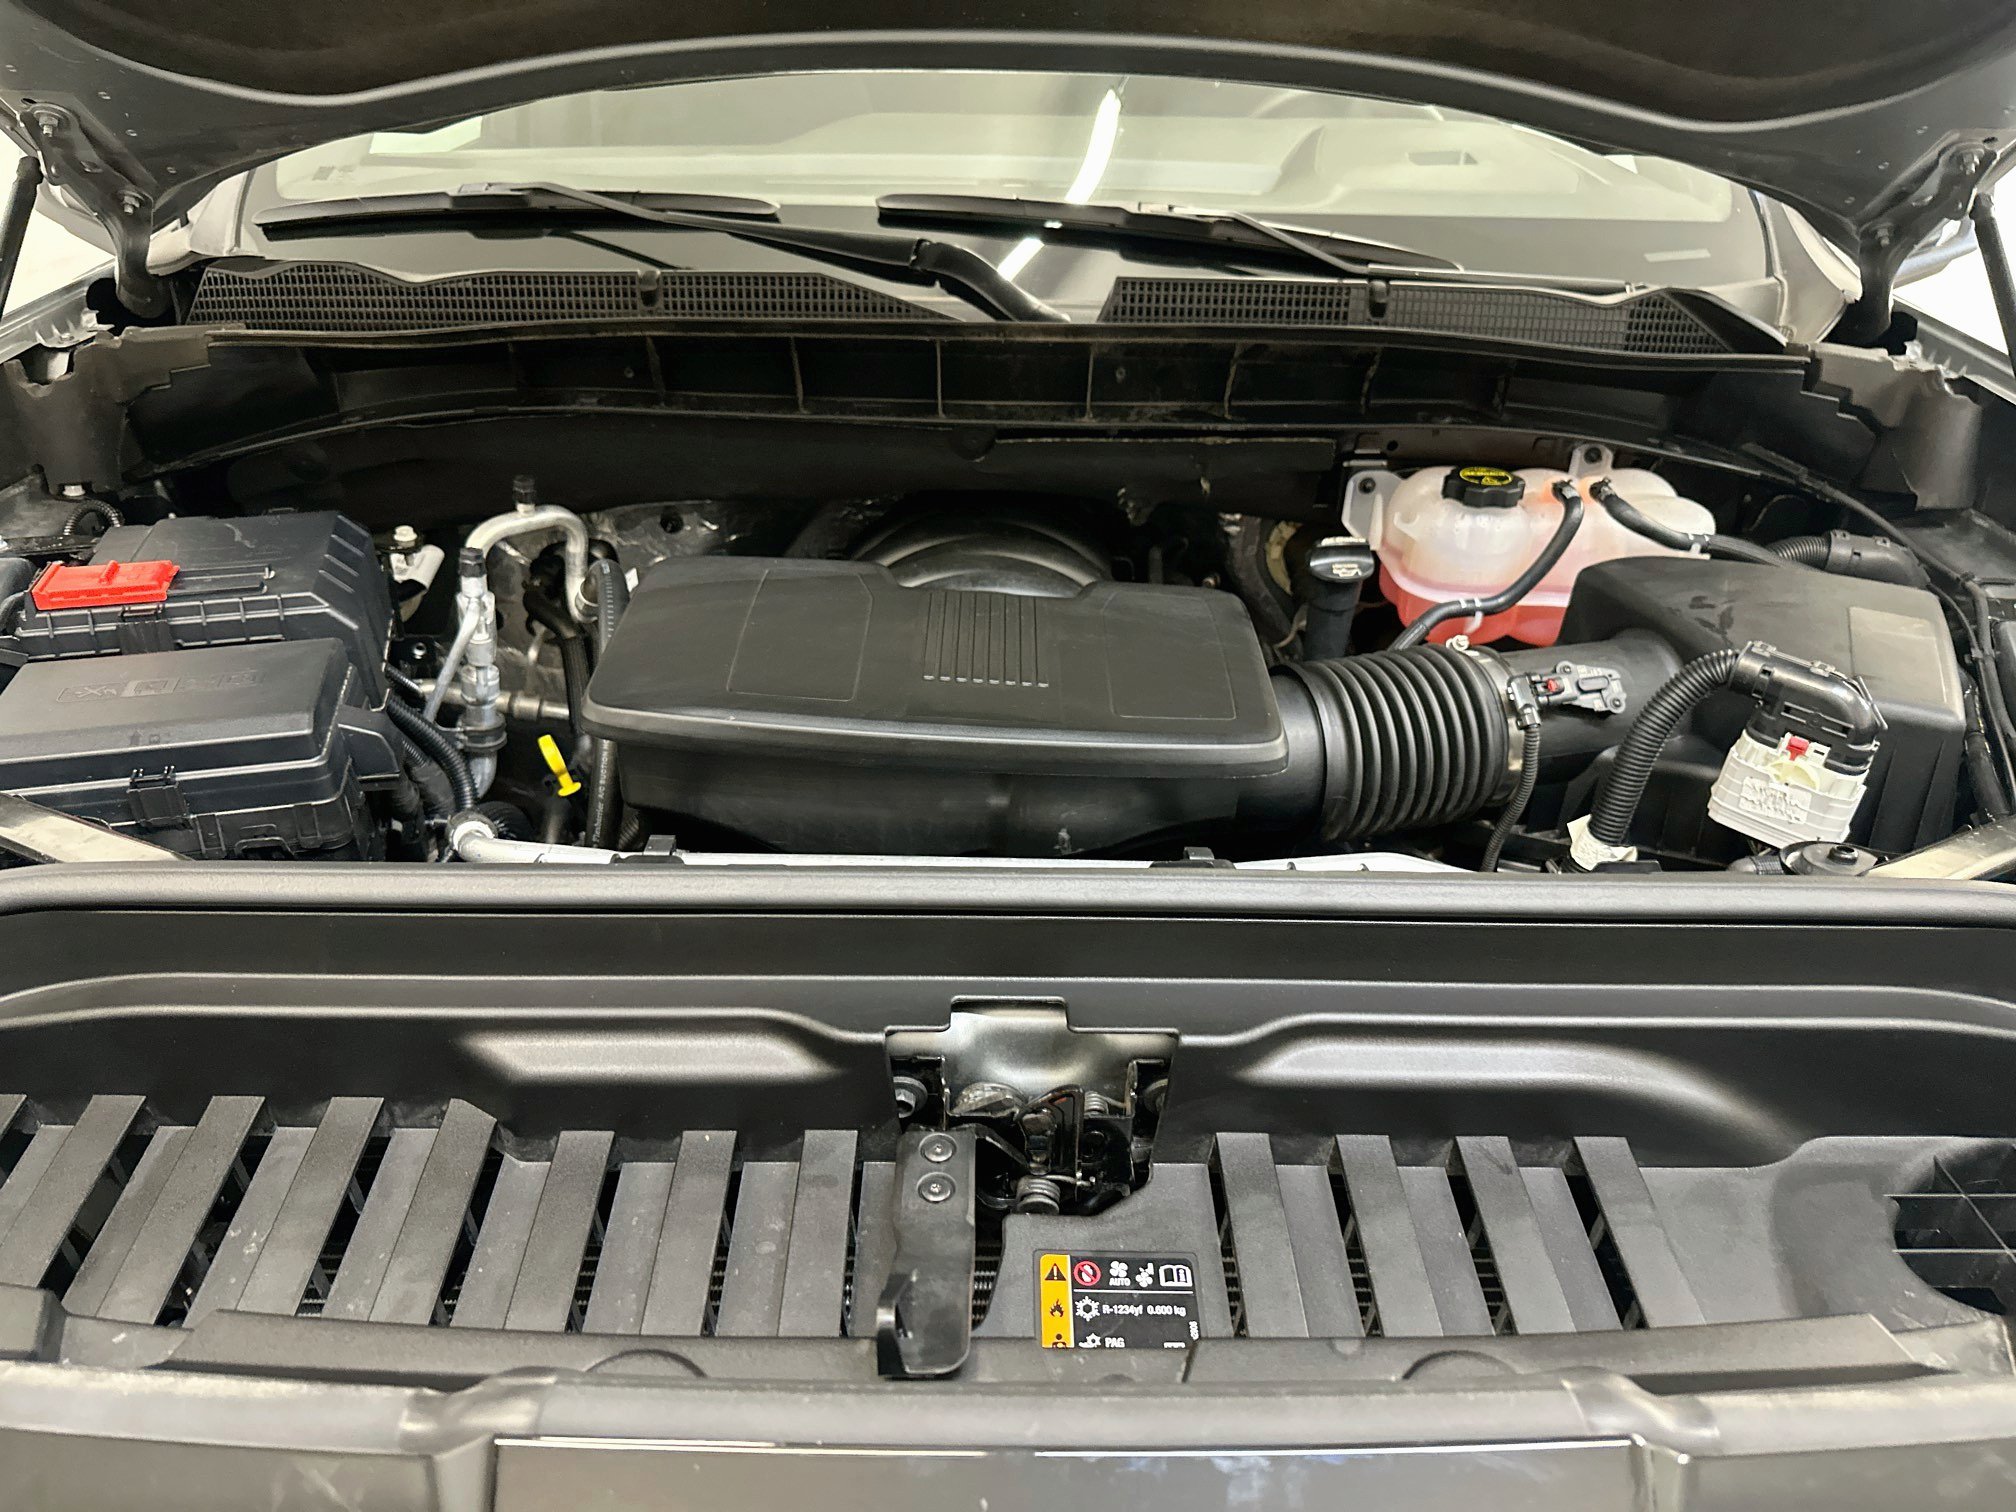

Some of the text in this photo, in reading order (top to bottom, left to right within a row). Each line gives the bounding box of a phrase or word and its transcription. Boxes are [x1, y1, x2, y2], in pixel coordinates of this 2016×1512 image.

[1109, 1278, 1131, 1286] AUTO
[1102, 1305, 1143, 1316] R-1234yf
[1174, 1306, 1186, 1317] kg
[1104, 1337, 1125, 1348] PAG
